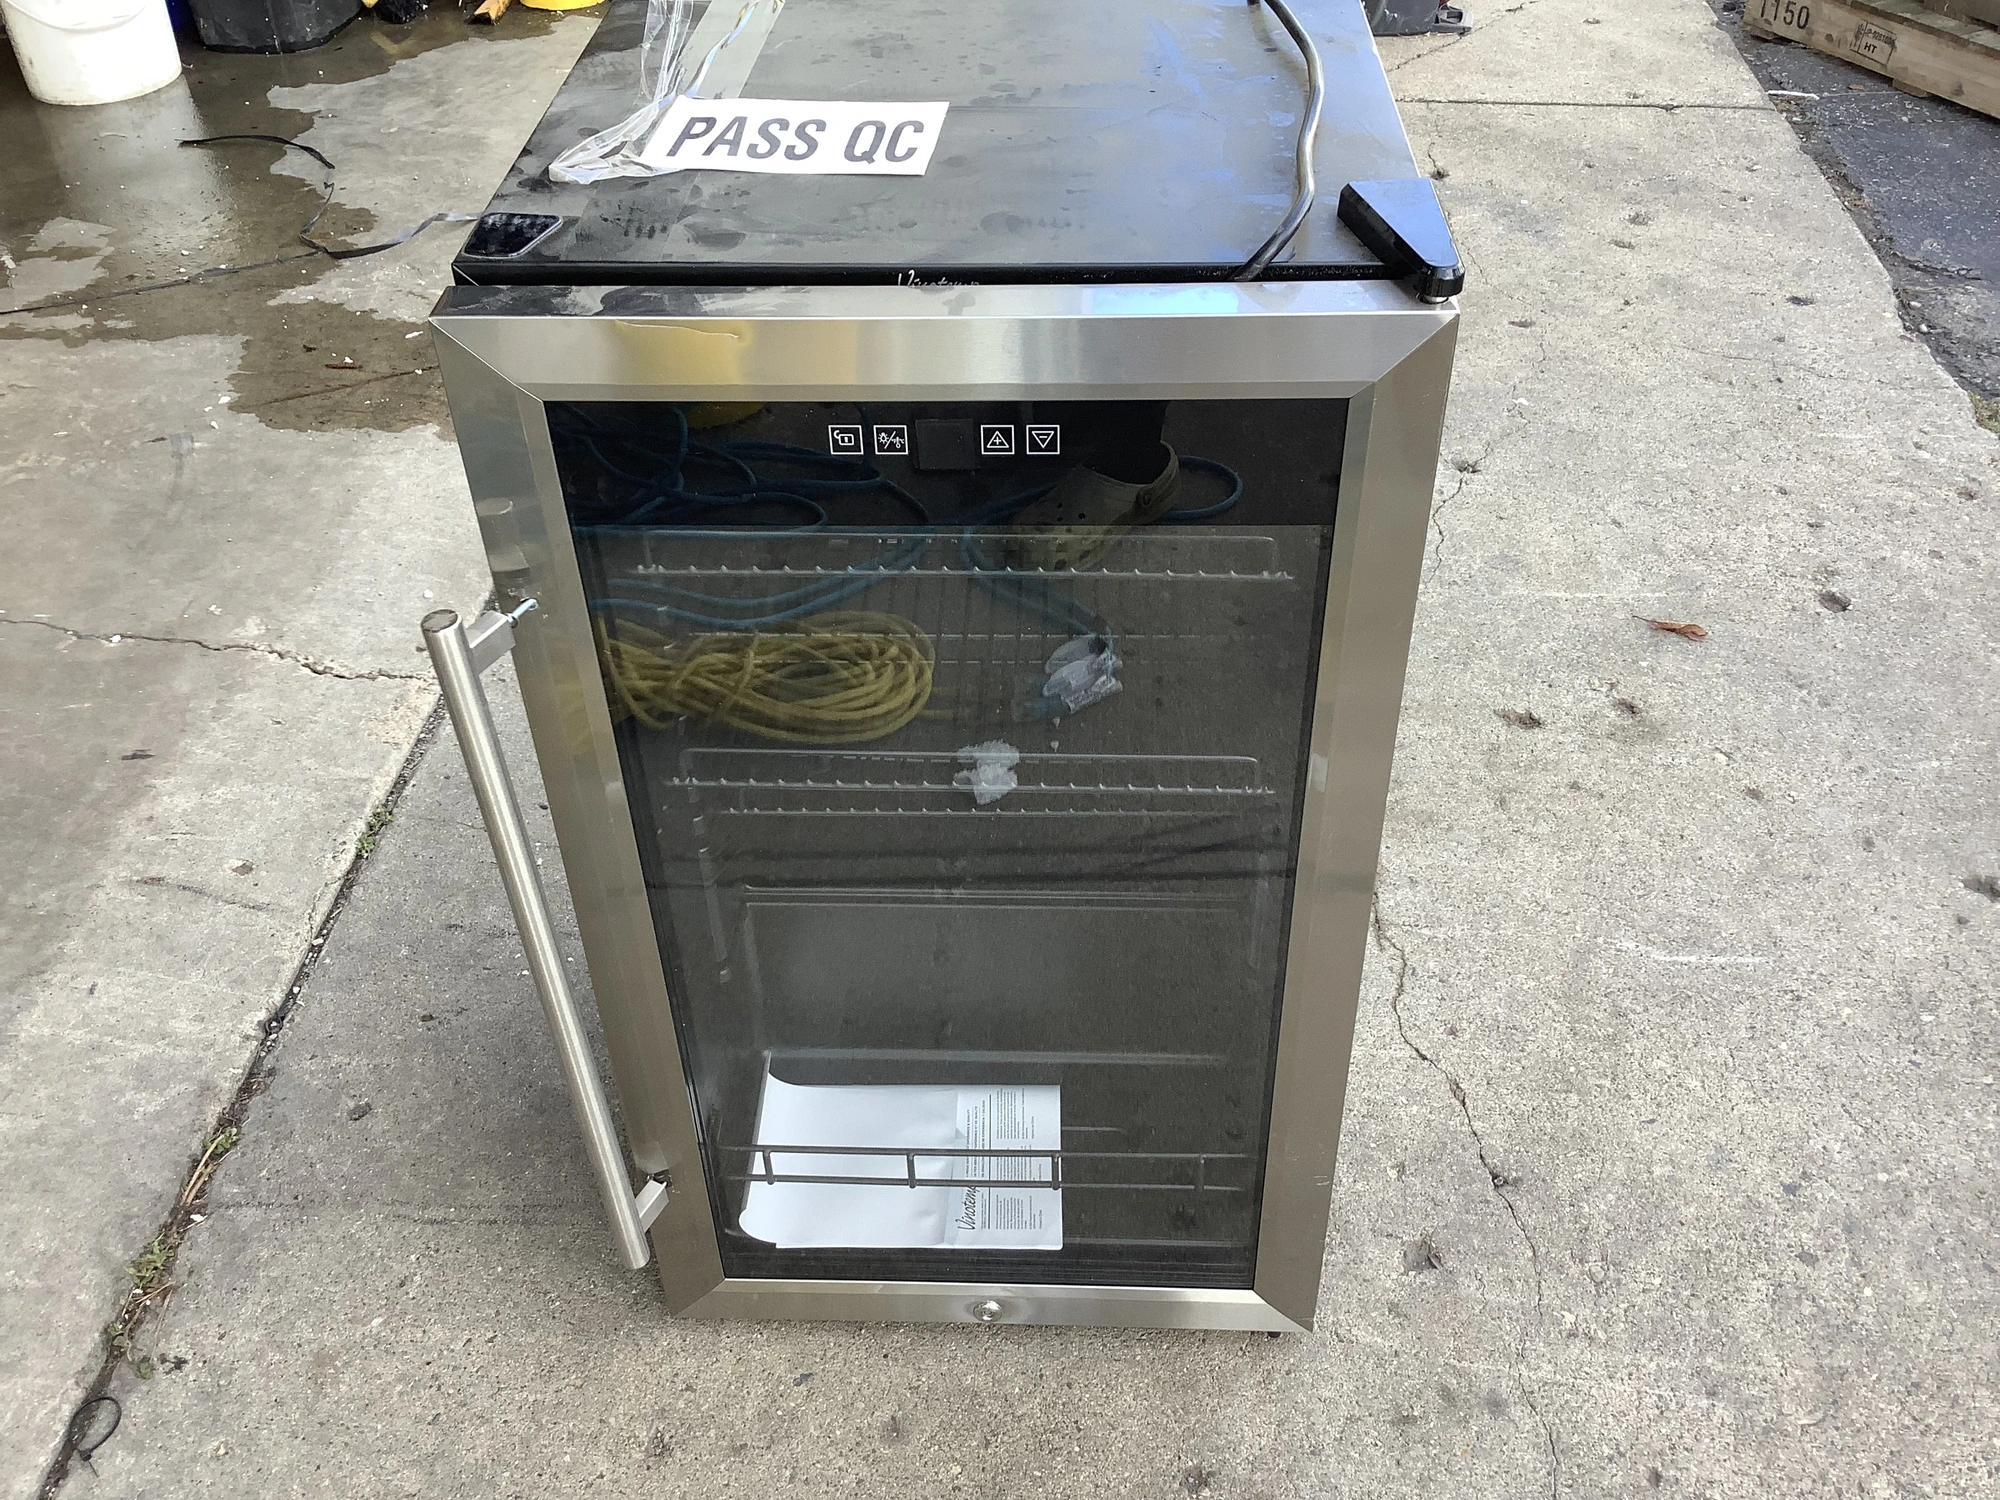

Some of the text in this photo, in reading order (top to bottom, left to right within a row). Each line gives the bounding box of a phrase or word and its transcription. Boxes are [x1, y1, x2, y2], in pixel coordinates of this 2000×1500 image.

[1863, 41, 1878, 54] HT
[665, 116, 924, 165] PASS QC
